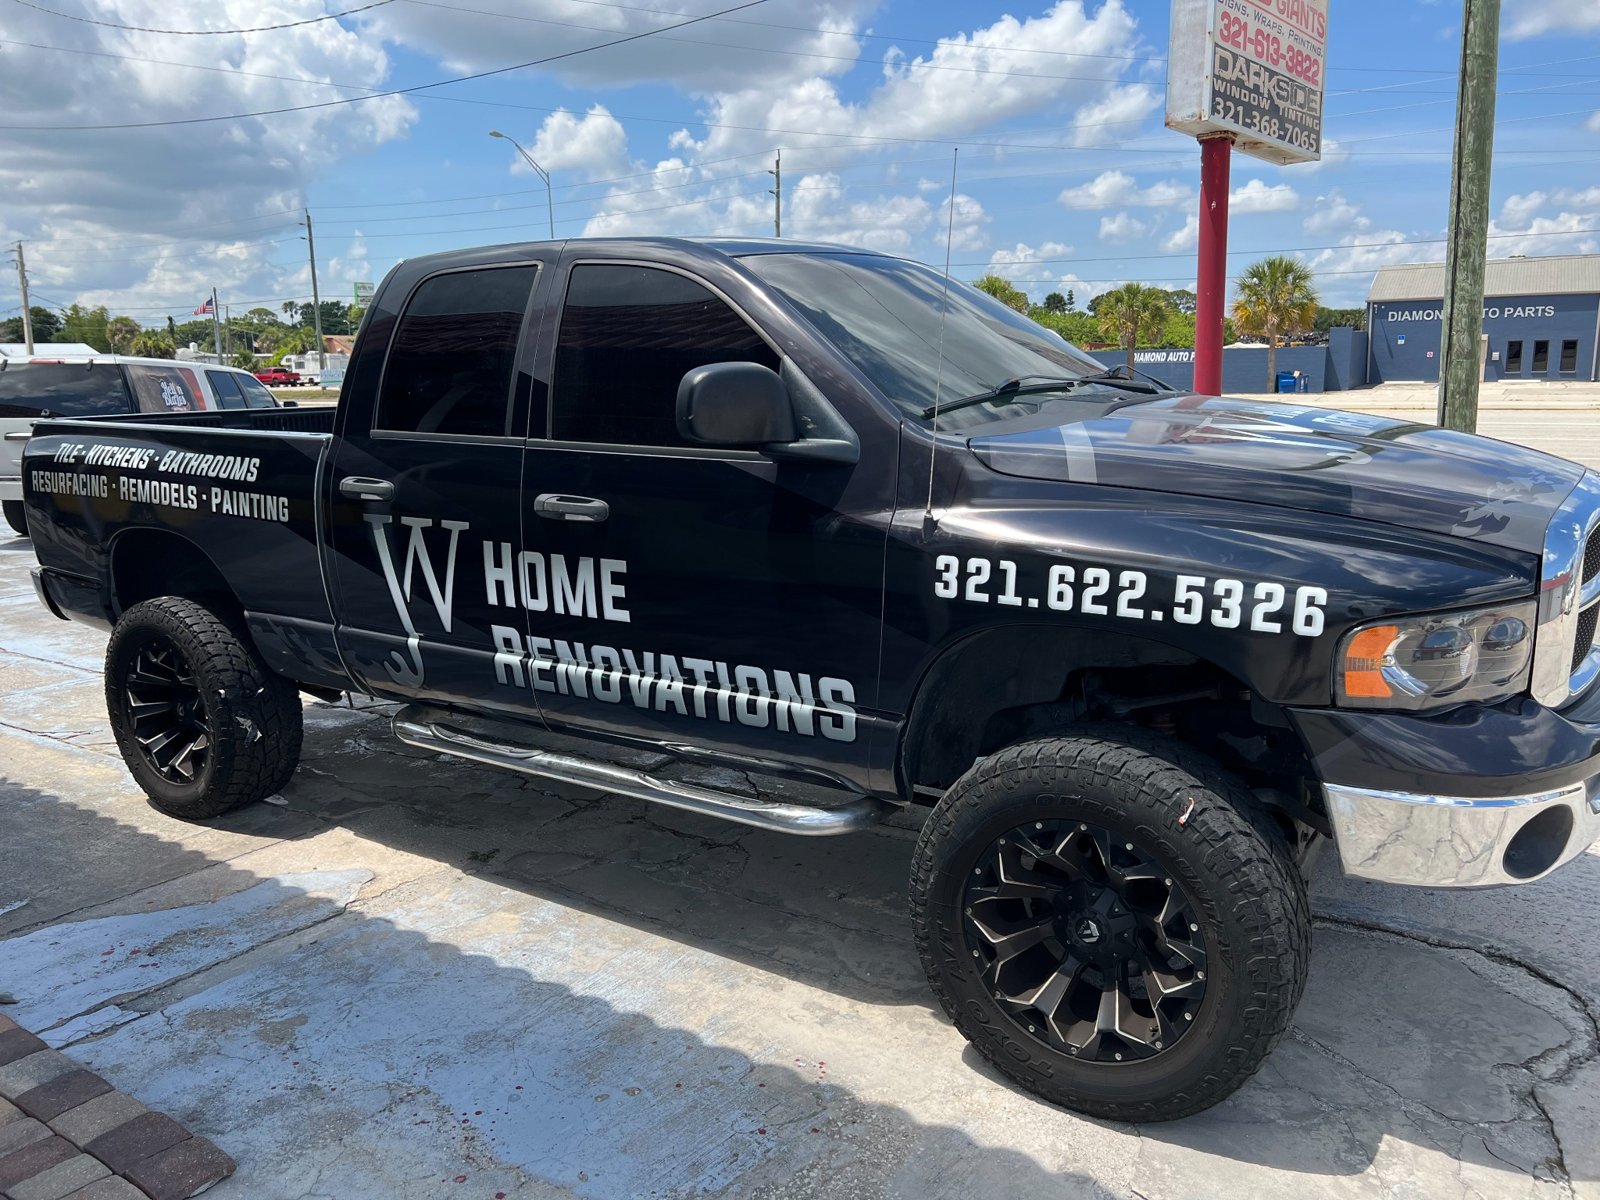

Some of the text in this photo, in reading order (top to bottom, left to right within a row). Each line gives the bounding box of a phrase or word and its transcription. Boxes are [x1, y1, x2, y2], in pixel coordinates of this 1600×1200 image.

[1276, 0, 1325, 39] GIANTS
[1220, 11, 1319, 86] 321-613-3822
[1213, 78, 1320, 130] WINDOW TINTING
[1214, 47, 1320, 116] DARKSIDE
[1214, 97, 1317, 151] 321-368-7065
[1387, 309, 1444, 322] DIAMON
[1504, 306, 1554, 318] PARTS
[1167, 351, 1189, 362] AUTO
[53, 443, 260, 482] TILE KITCHENS BATHROOMS
[31, 470, 289, 522] RESURFACING REMODELS PAINTING
[483, 540, 631, 623] HOME
[934, 555, 1328, 637] 321.622.5326
[491, 624, 857, 742] RENOVATIONS
[965, 998, 1055, 1079] TOYO
